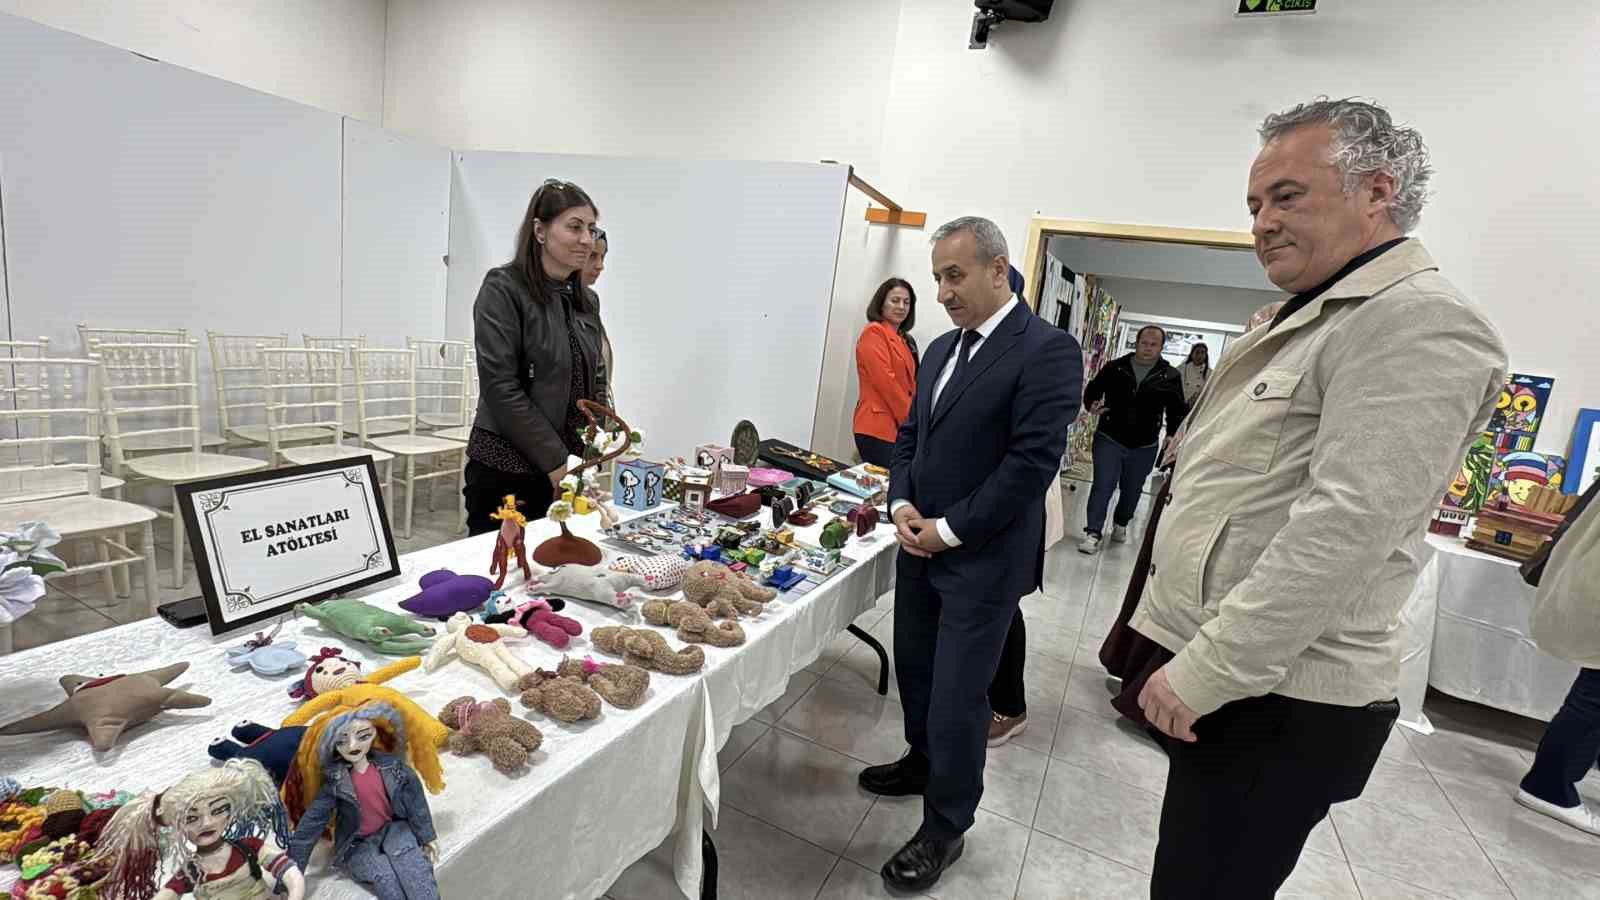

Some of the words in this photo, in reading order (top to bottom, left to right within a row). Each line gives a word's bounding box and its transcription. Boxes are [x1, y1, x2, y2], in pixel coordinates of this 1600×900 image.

[240, 528, 263, 544] EL
[264, 509, 350, 538] SANATLARI
[267, 526, 338, 557] ATÖLYESİ
